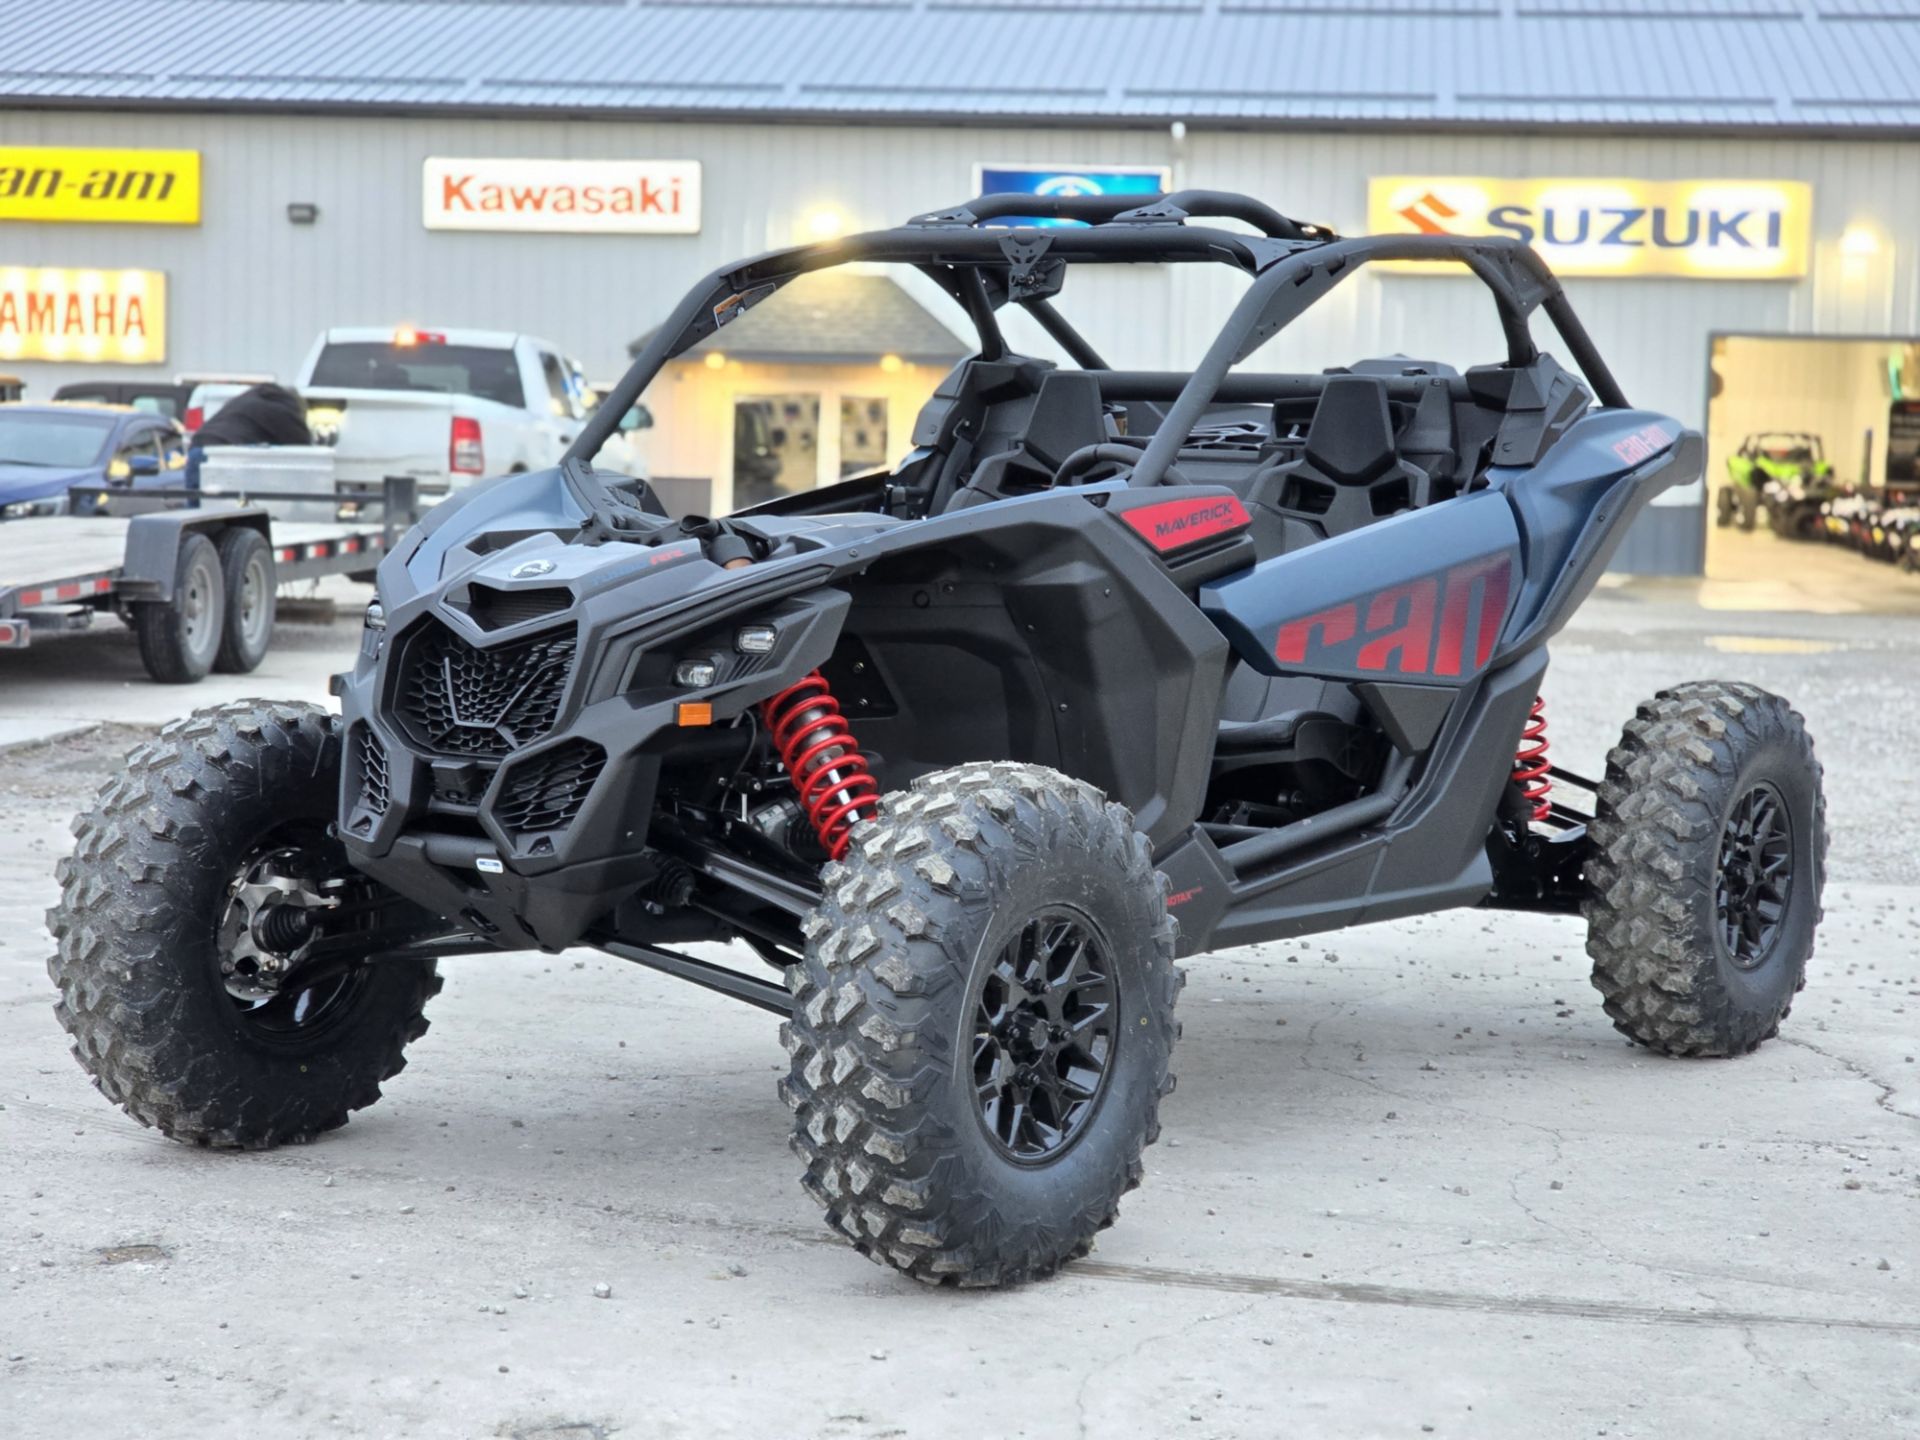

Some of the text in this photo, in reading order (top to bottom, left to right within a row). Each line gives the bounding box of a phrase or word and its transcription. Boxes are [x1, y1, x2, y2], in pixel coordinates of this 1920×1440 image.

[442, 174, 681, 214] Kawasaki
[1487, 206, 1781, 247] SUZUKI
[0, 291, 146, 336] AMAHA
[1155, 503, 1233, 537] MAVERICK
